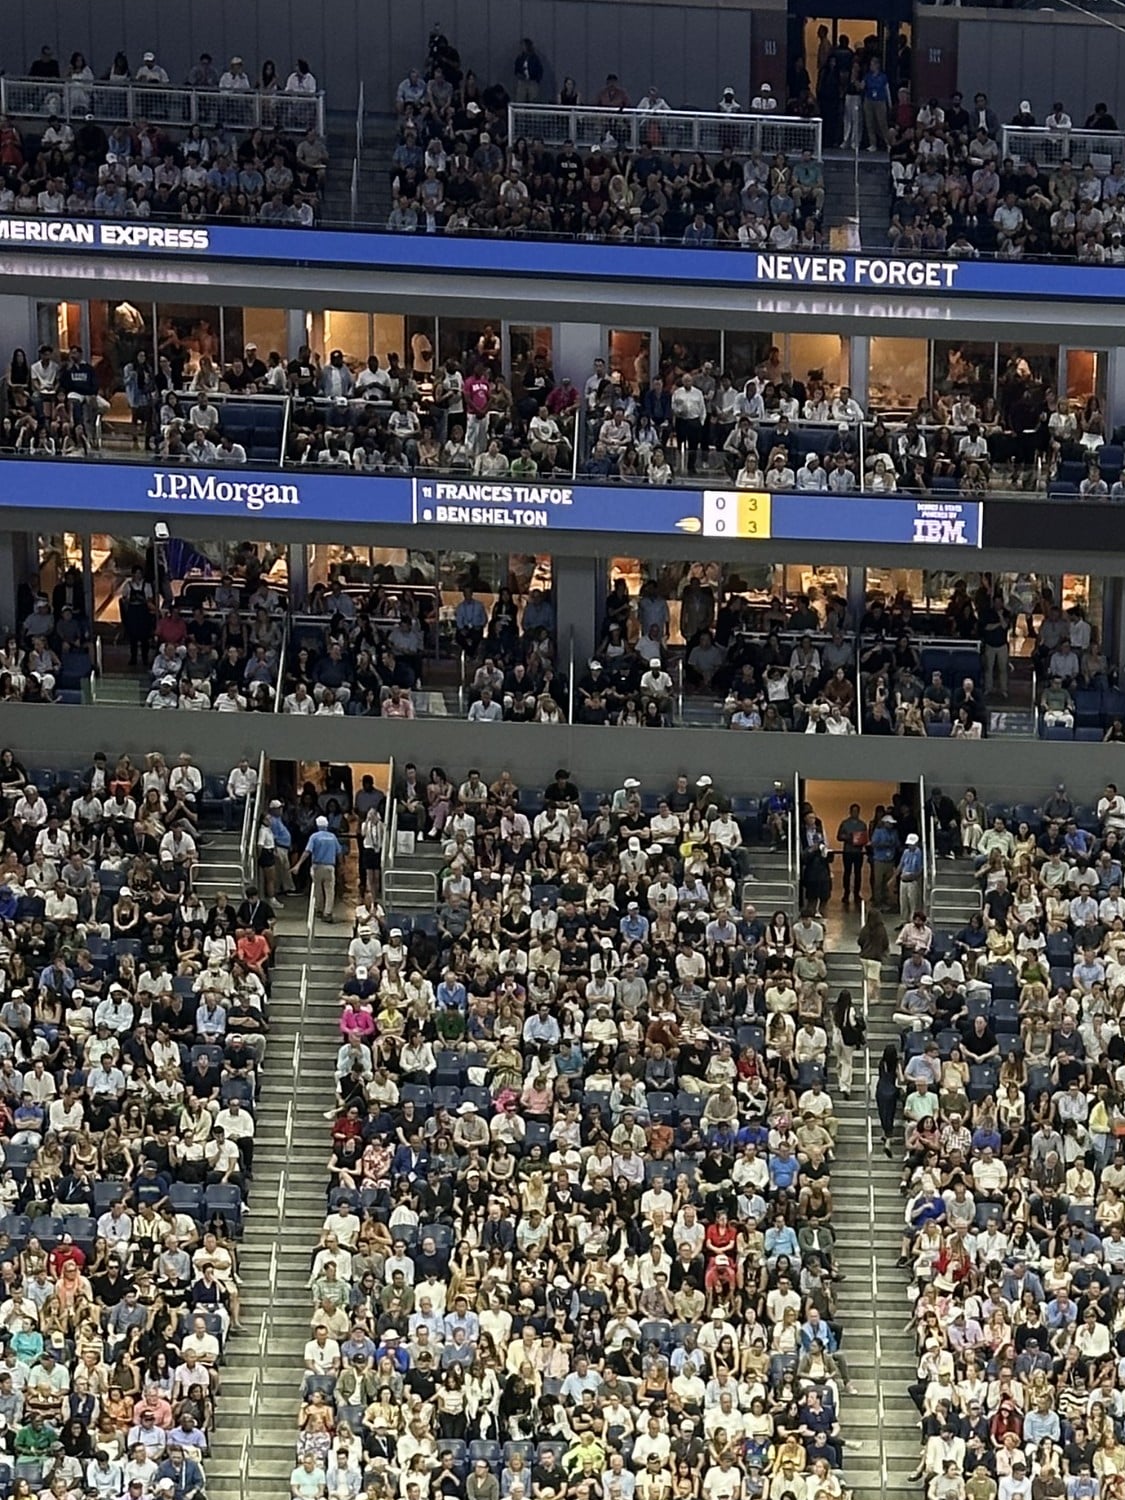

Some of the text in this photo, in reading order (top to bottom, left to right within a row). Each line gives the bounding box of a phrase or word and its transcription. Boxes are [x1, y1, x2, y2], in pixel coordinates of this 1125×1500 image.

[100, 224, 209, 248] EXPRESS
[757, 254, 959, 287] NEVER FORGET
[147, 473, 300, 510] J.P.Morgan
[436, 483, 512, 502] FRANCES
[514, 486, 573, 505] TIAFOE
[715, 496, 758, 512] 0 3
[436, 506, 470, 522] BEN
[471, 507, 548, 526] SHELTON
[715, 519, 758, 534] 0 3
[913, 519, 968, 543] IBM
